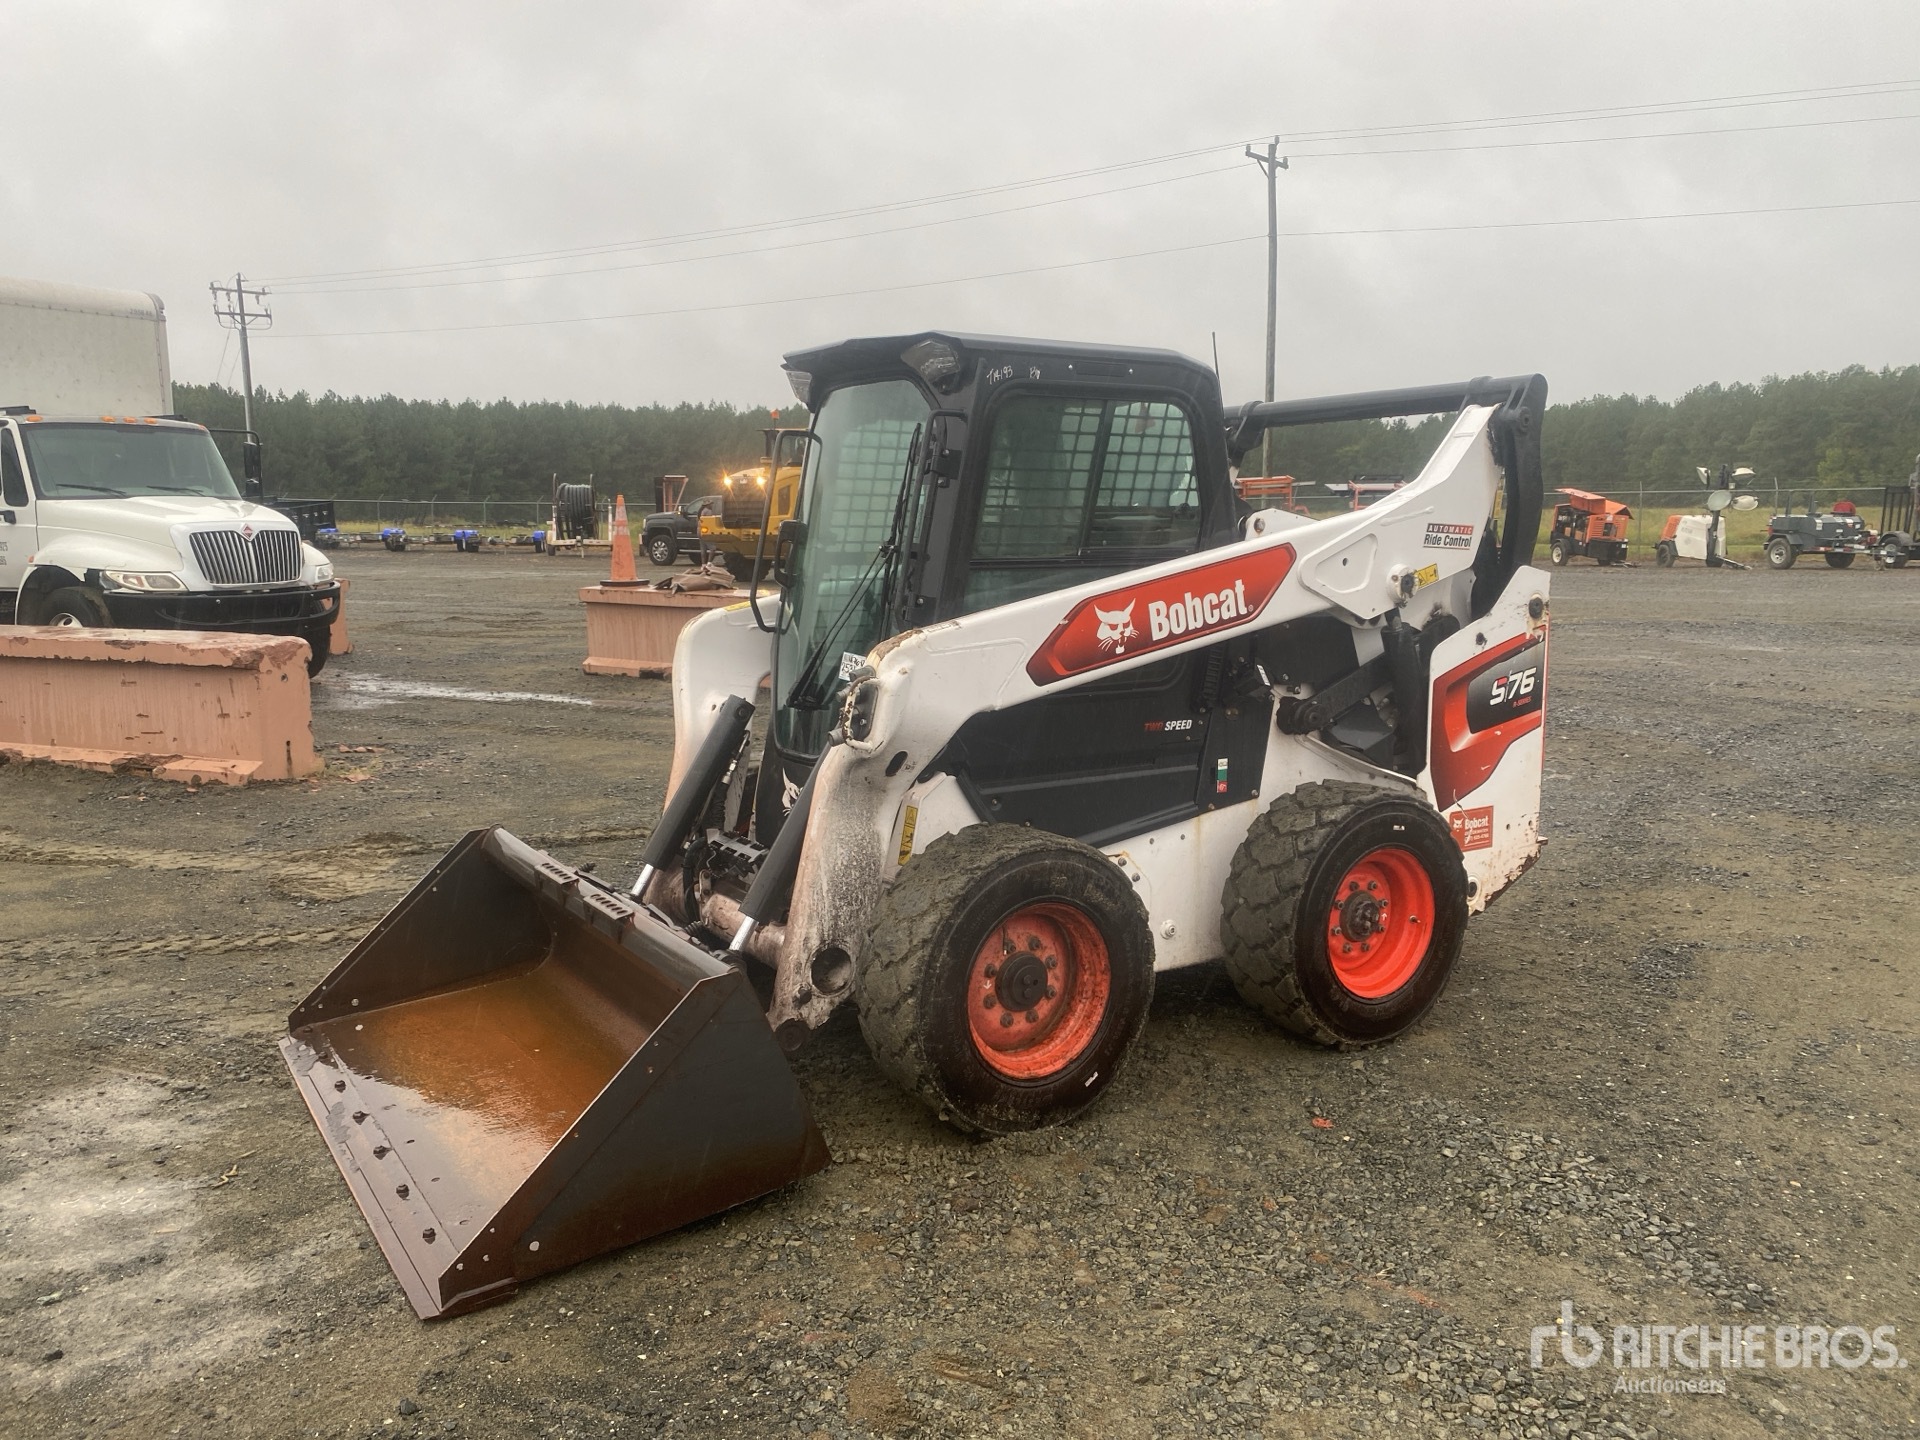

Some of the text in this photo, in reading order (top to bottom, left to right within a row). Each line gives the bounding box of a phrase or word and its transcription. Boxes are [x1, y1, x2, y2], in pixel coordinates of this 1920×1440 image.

[1427, 525, 1473, 535] AUTOMATIC
[1423, 534, 1472, 548] Ride Control
[1148, 579, 1248, 641] Bobcat
[1489, 667, 1537, 705] S76
[1164, 719, 1193, 731] SPEED
[1465, 816, 1489, 830] Bobcat
